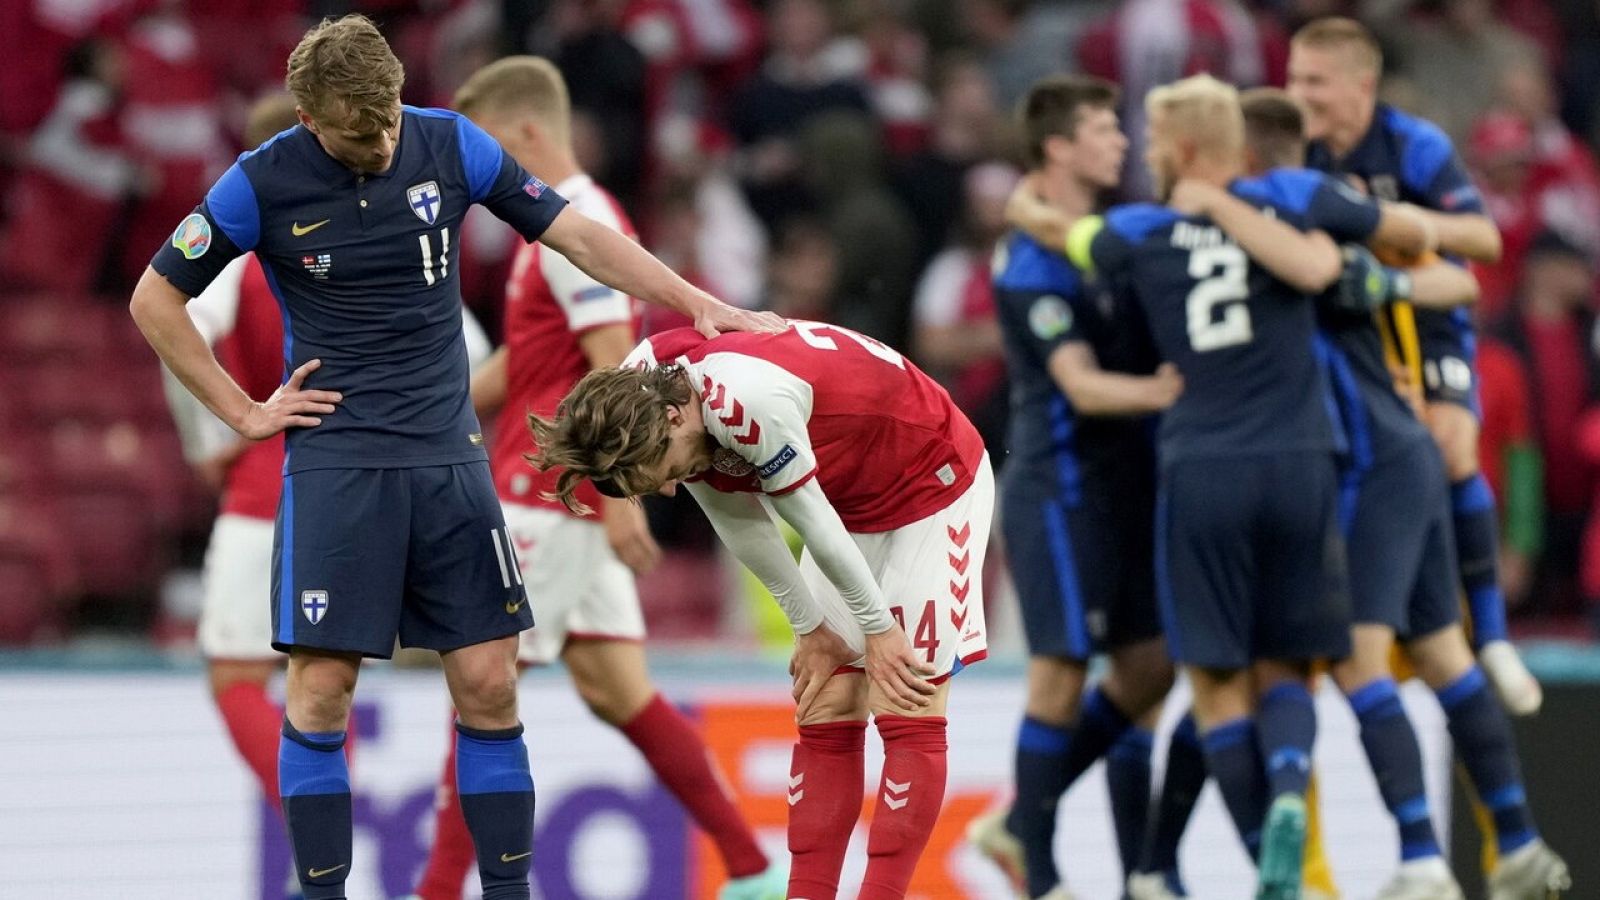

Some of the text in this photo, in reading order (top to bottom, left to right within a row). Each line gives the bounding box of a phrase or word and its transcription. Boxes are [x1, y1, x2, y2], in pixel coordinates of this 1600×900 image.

[419, 227, 450, 286] 11
[1185, 243, 1254, 352] 2
[760, 447, 794, 476] RESPECT
[491, 525, 523, 588] 11
